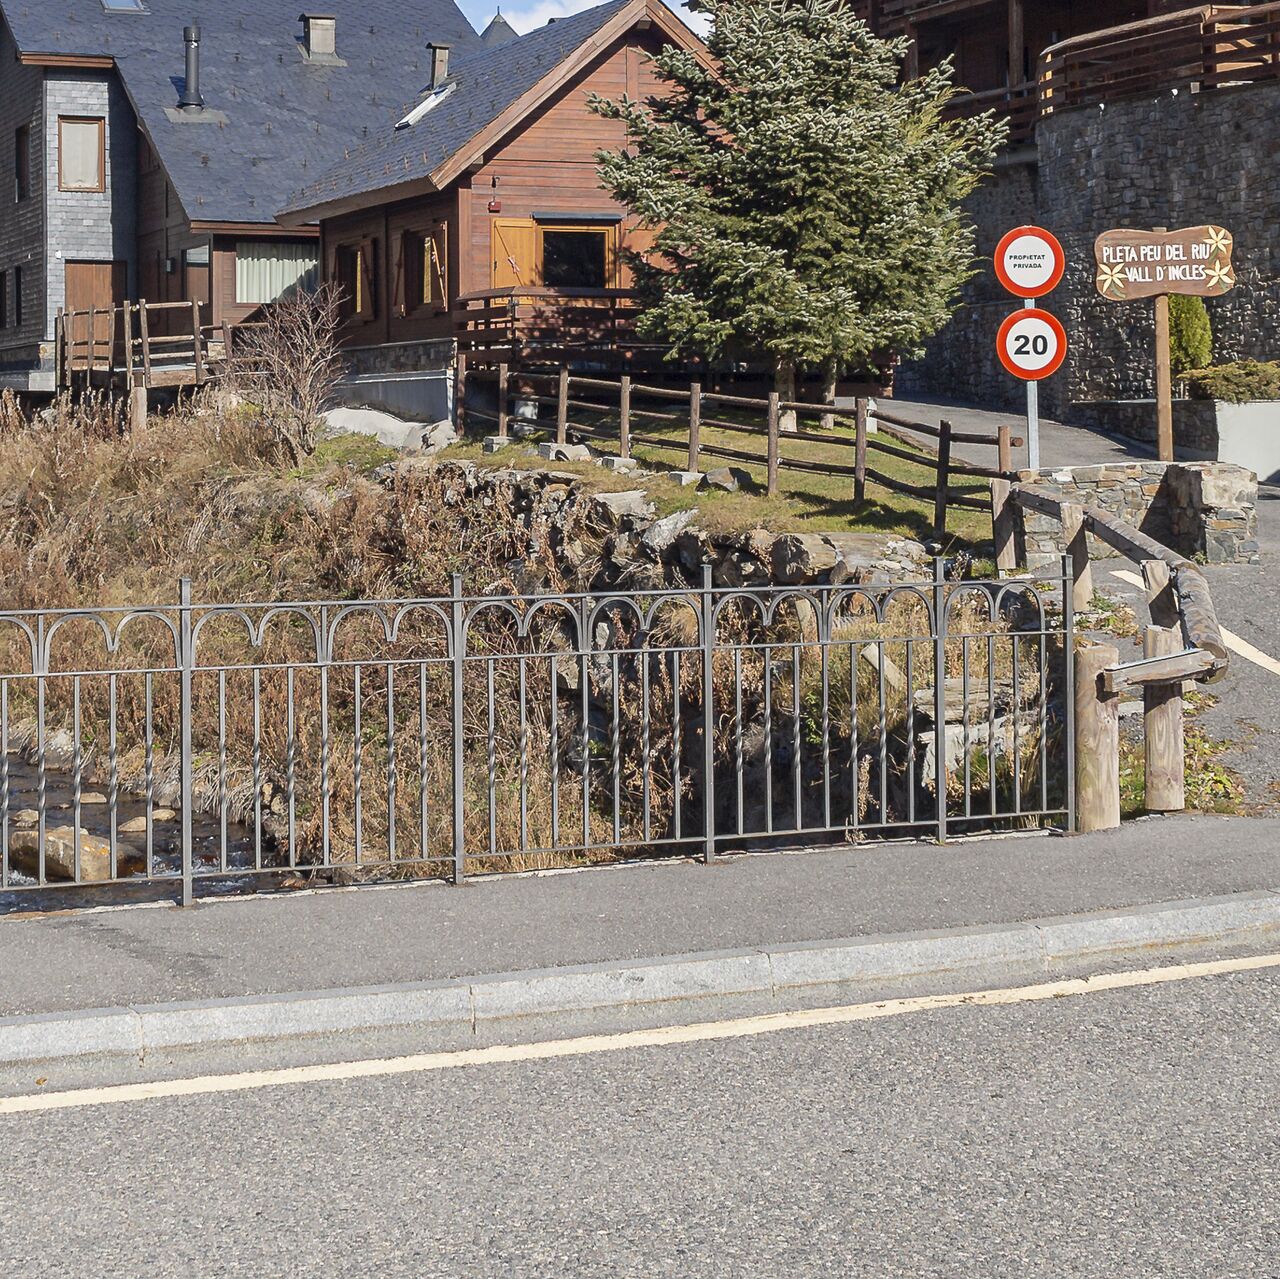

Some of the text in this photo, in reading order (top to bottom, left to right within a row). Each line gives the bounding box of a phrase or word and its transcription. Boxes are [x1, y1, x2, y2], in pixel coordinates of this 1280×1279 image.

[1103, 243, 1210, 263] PLETA PEU DEL RIU
[1125, 265, 1153, 282] VALL
[1014, 335, 1048, 355] 20
